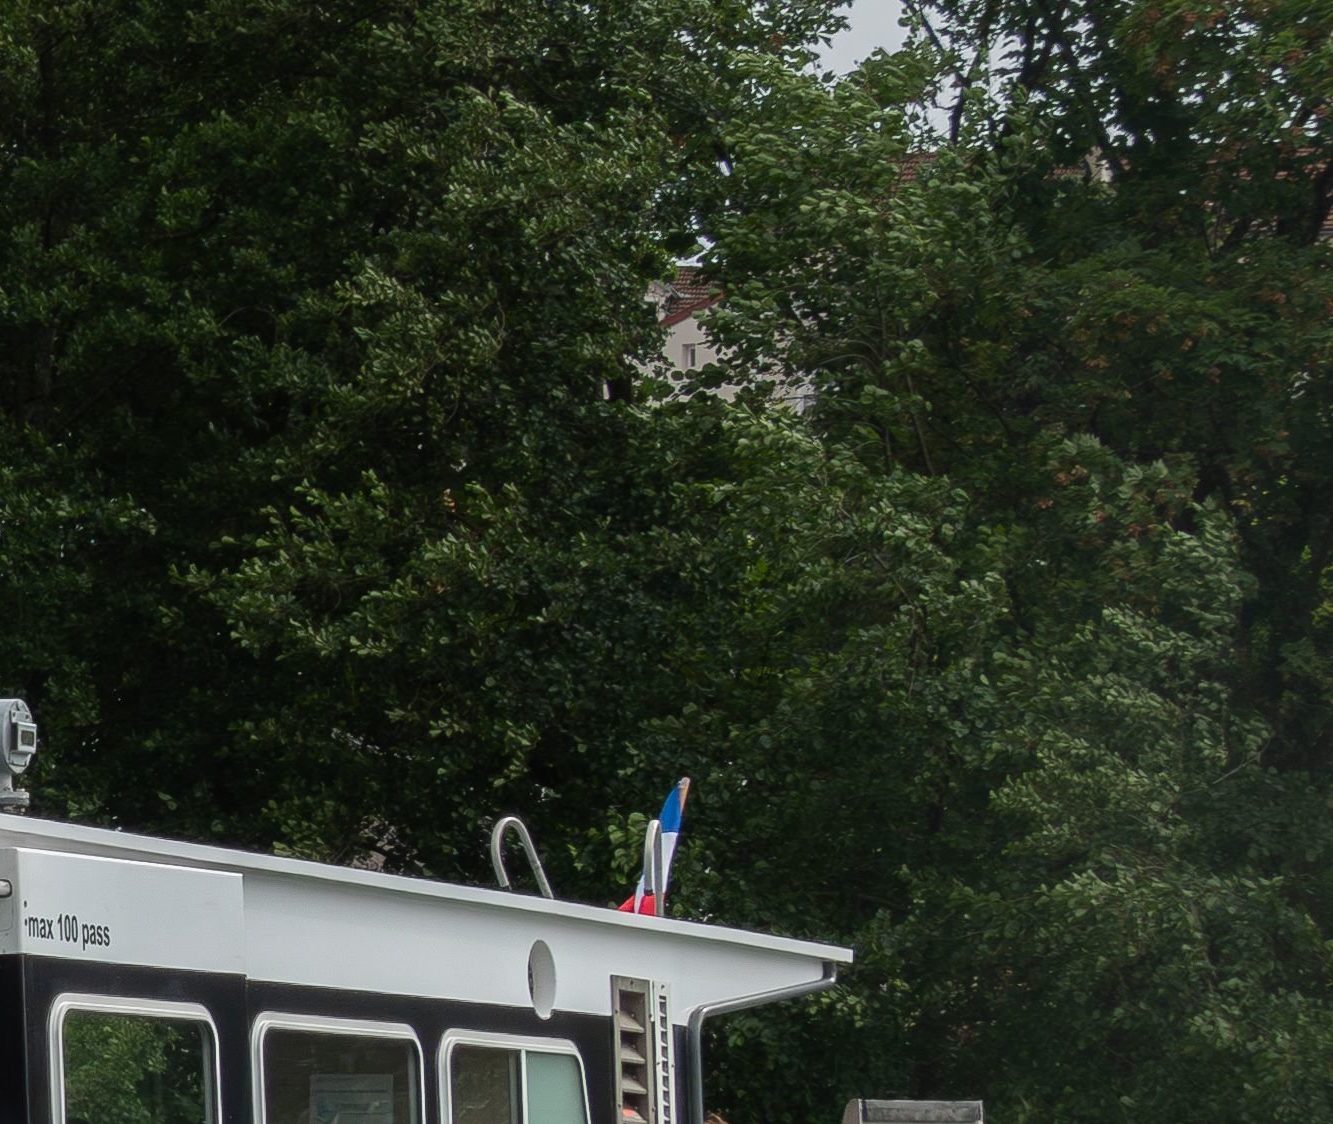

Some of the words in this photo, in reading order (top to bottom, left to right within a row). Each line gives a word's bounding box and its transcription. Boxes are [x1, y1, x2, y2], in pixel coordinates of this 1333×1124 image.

[27, 915, 54, 939] max
[57, 914, 78, 943] 100
[82, 923, 111, 950] pass
